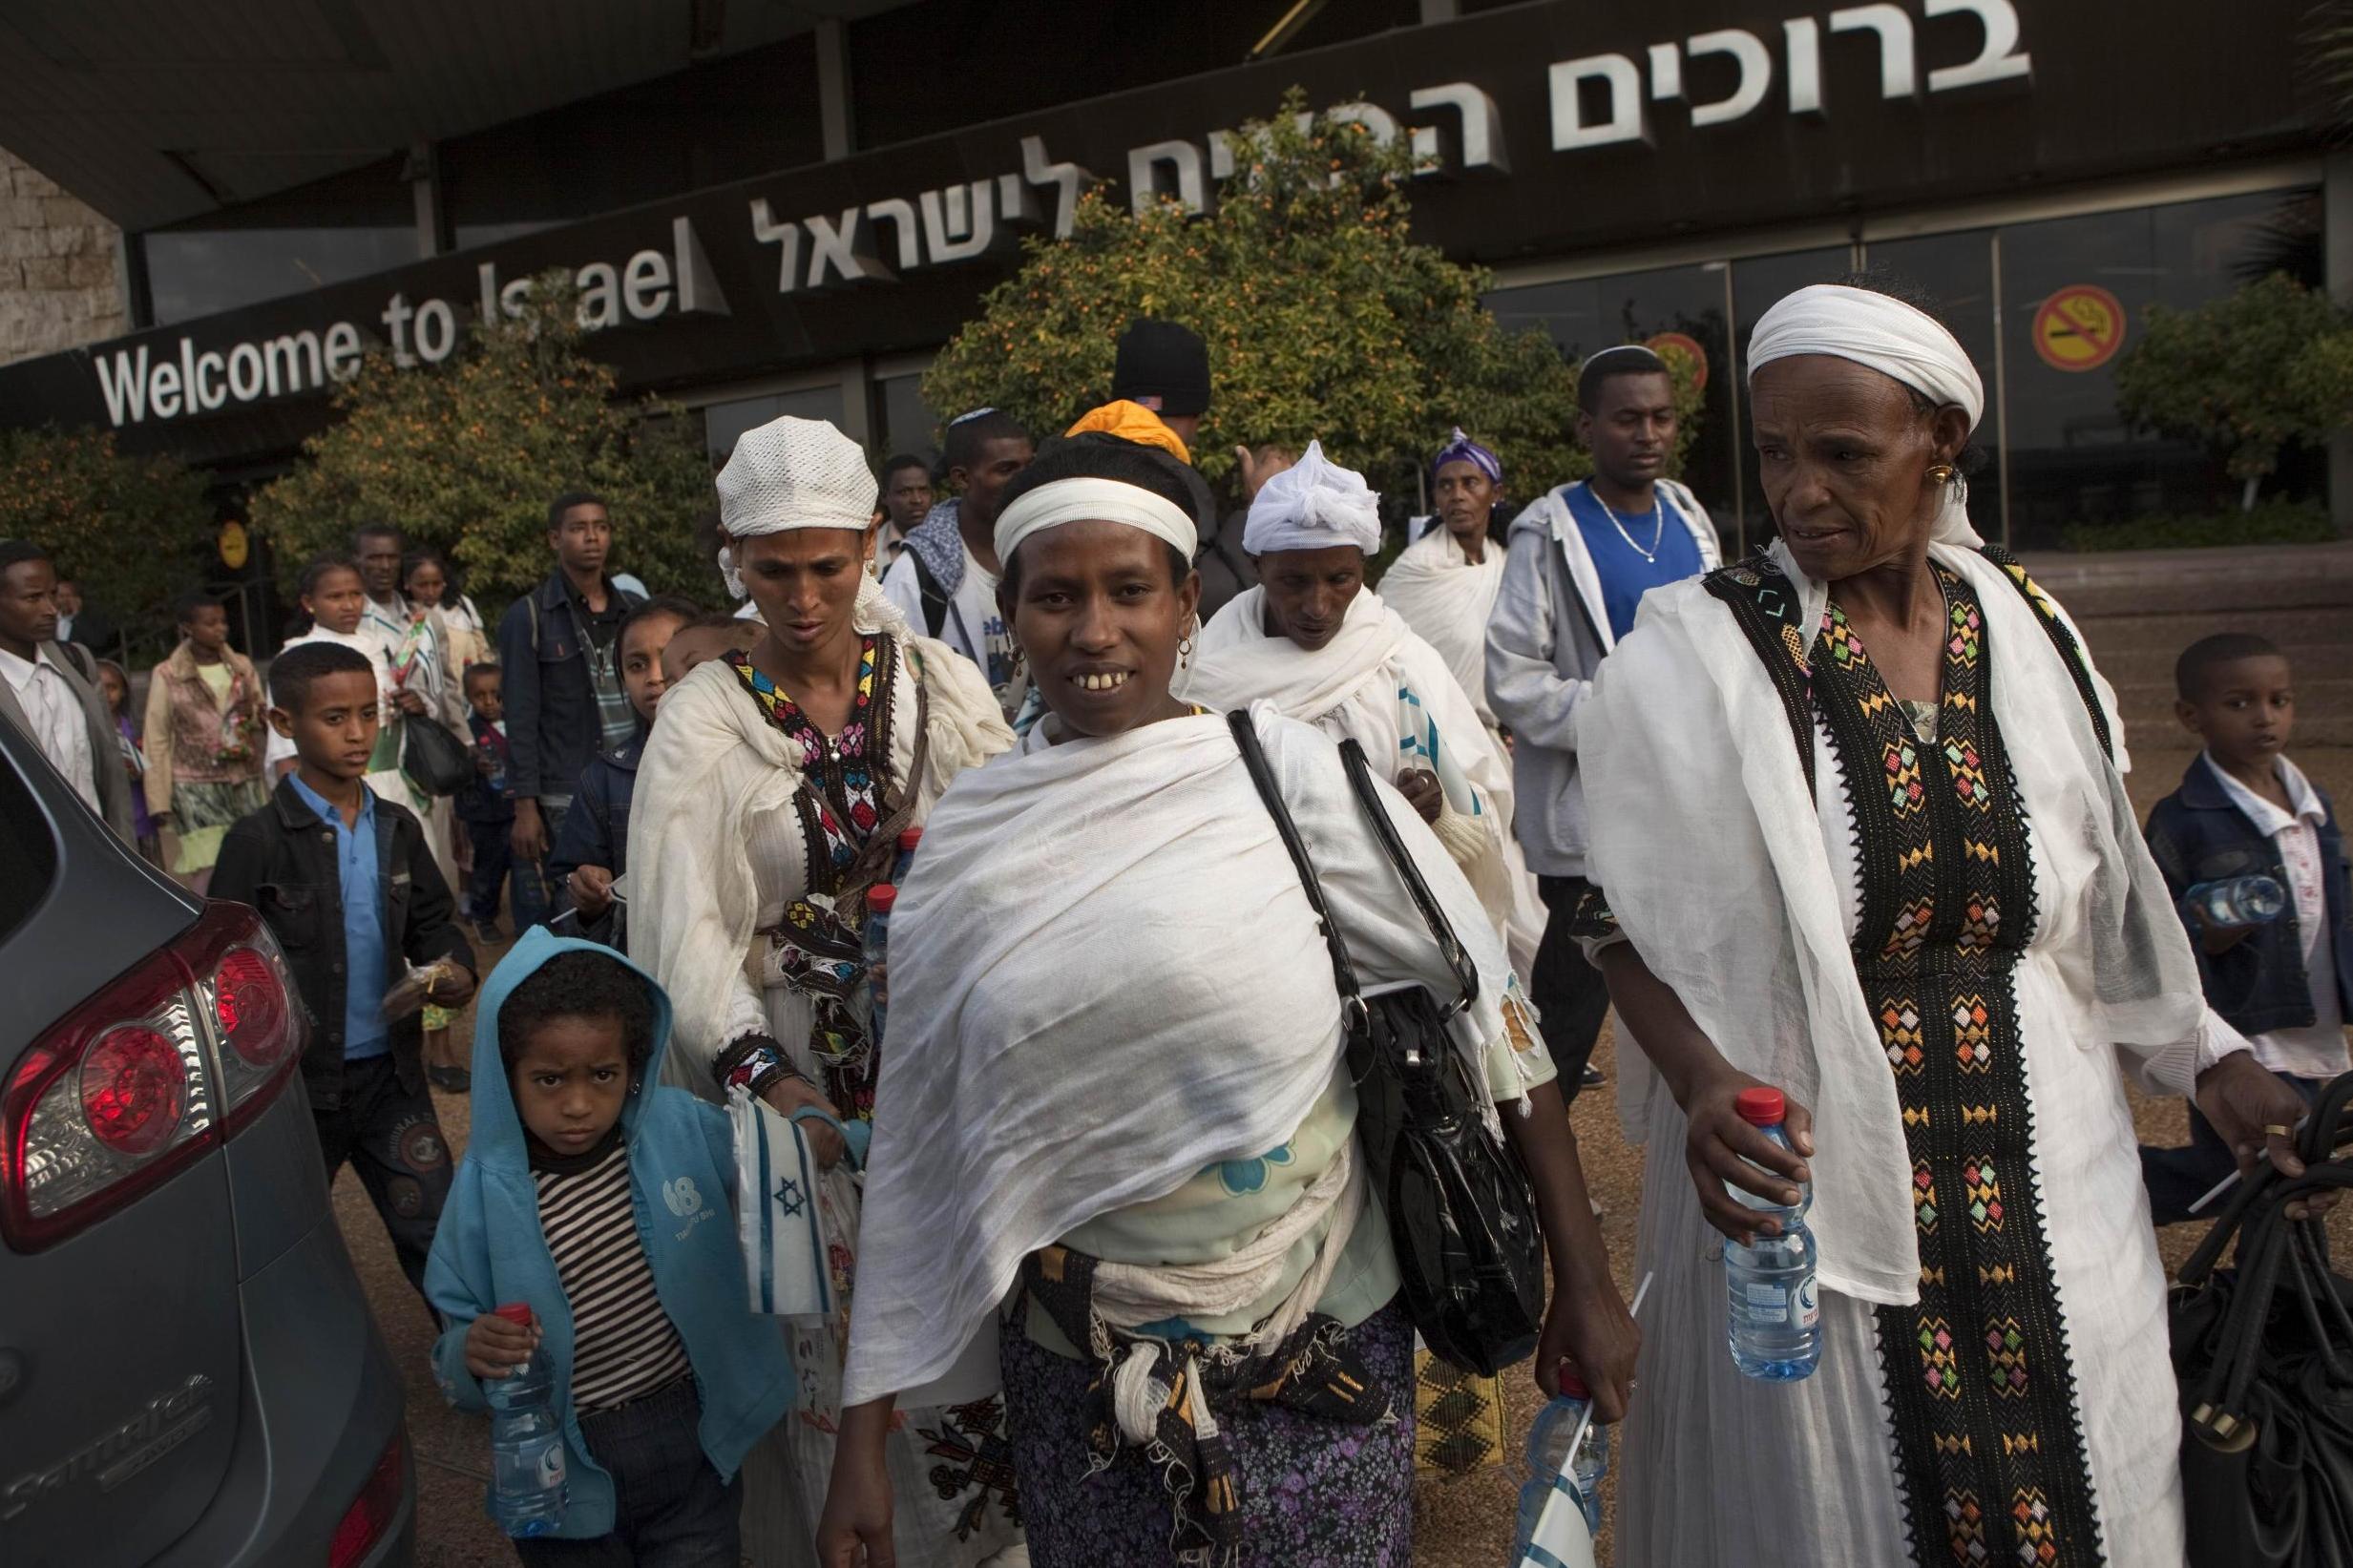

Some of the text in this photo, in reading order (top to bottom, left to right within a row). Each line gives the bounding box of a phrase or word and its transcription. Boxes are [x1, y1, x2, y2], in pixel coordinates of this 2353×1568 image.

[1548, 0, 2031, 151] ברוכים
[749, 135, 1080, 293] לישראל
[95, 216, 696, 428] Welcome to Isael
